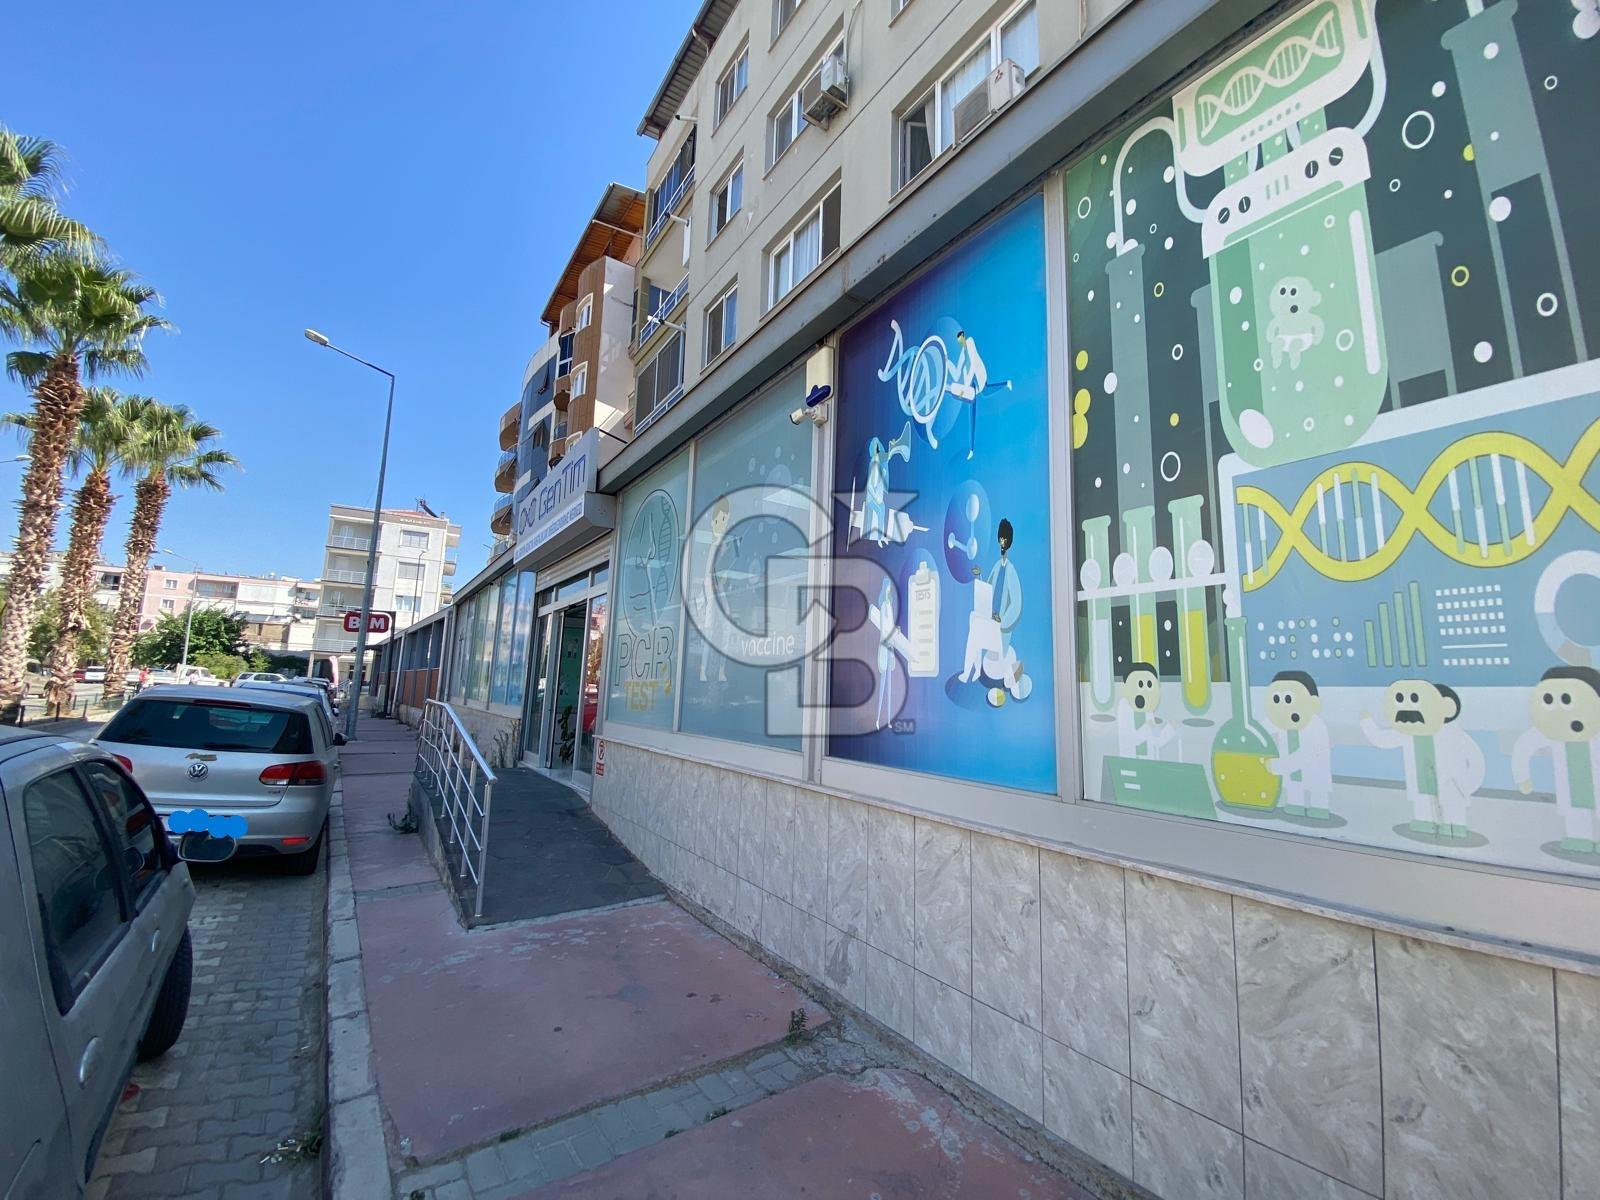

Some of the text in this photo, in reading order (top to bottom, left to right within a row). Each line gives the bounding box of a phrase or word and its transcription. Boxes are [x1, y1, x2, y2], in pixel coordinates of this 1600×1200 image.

[348, 616, 385, 629] BM
[615, 626, 674, 686] PCR
[741, 631, 795, 656] vaccine
[624, 680, 658, 711] TEST
